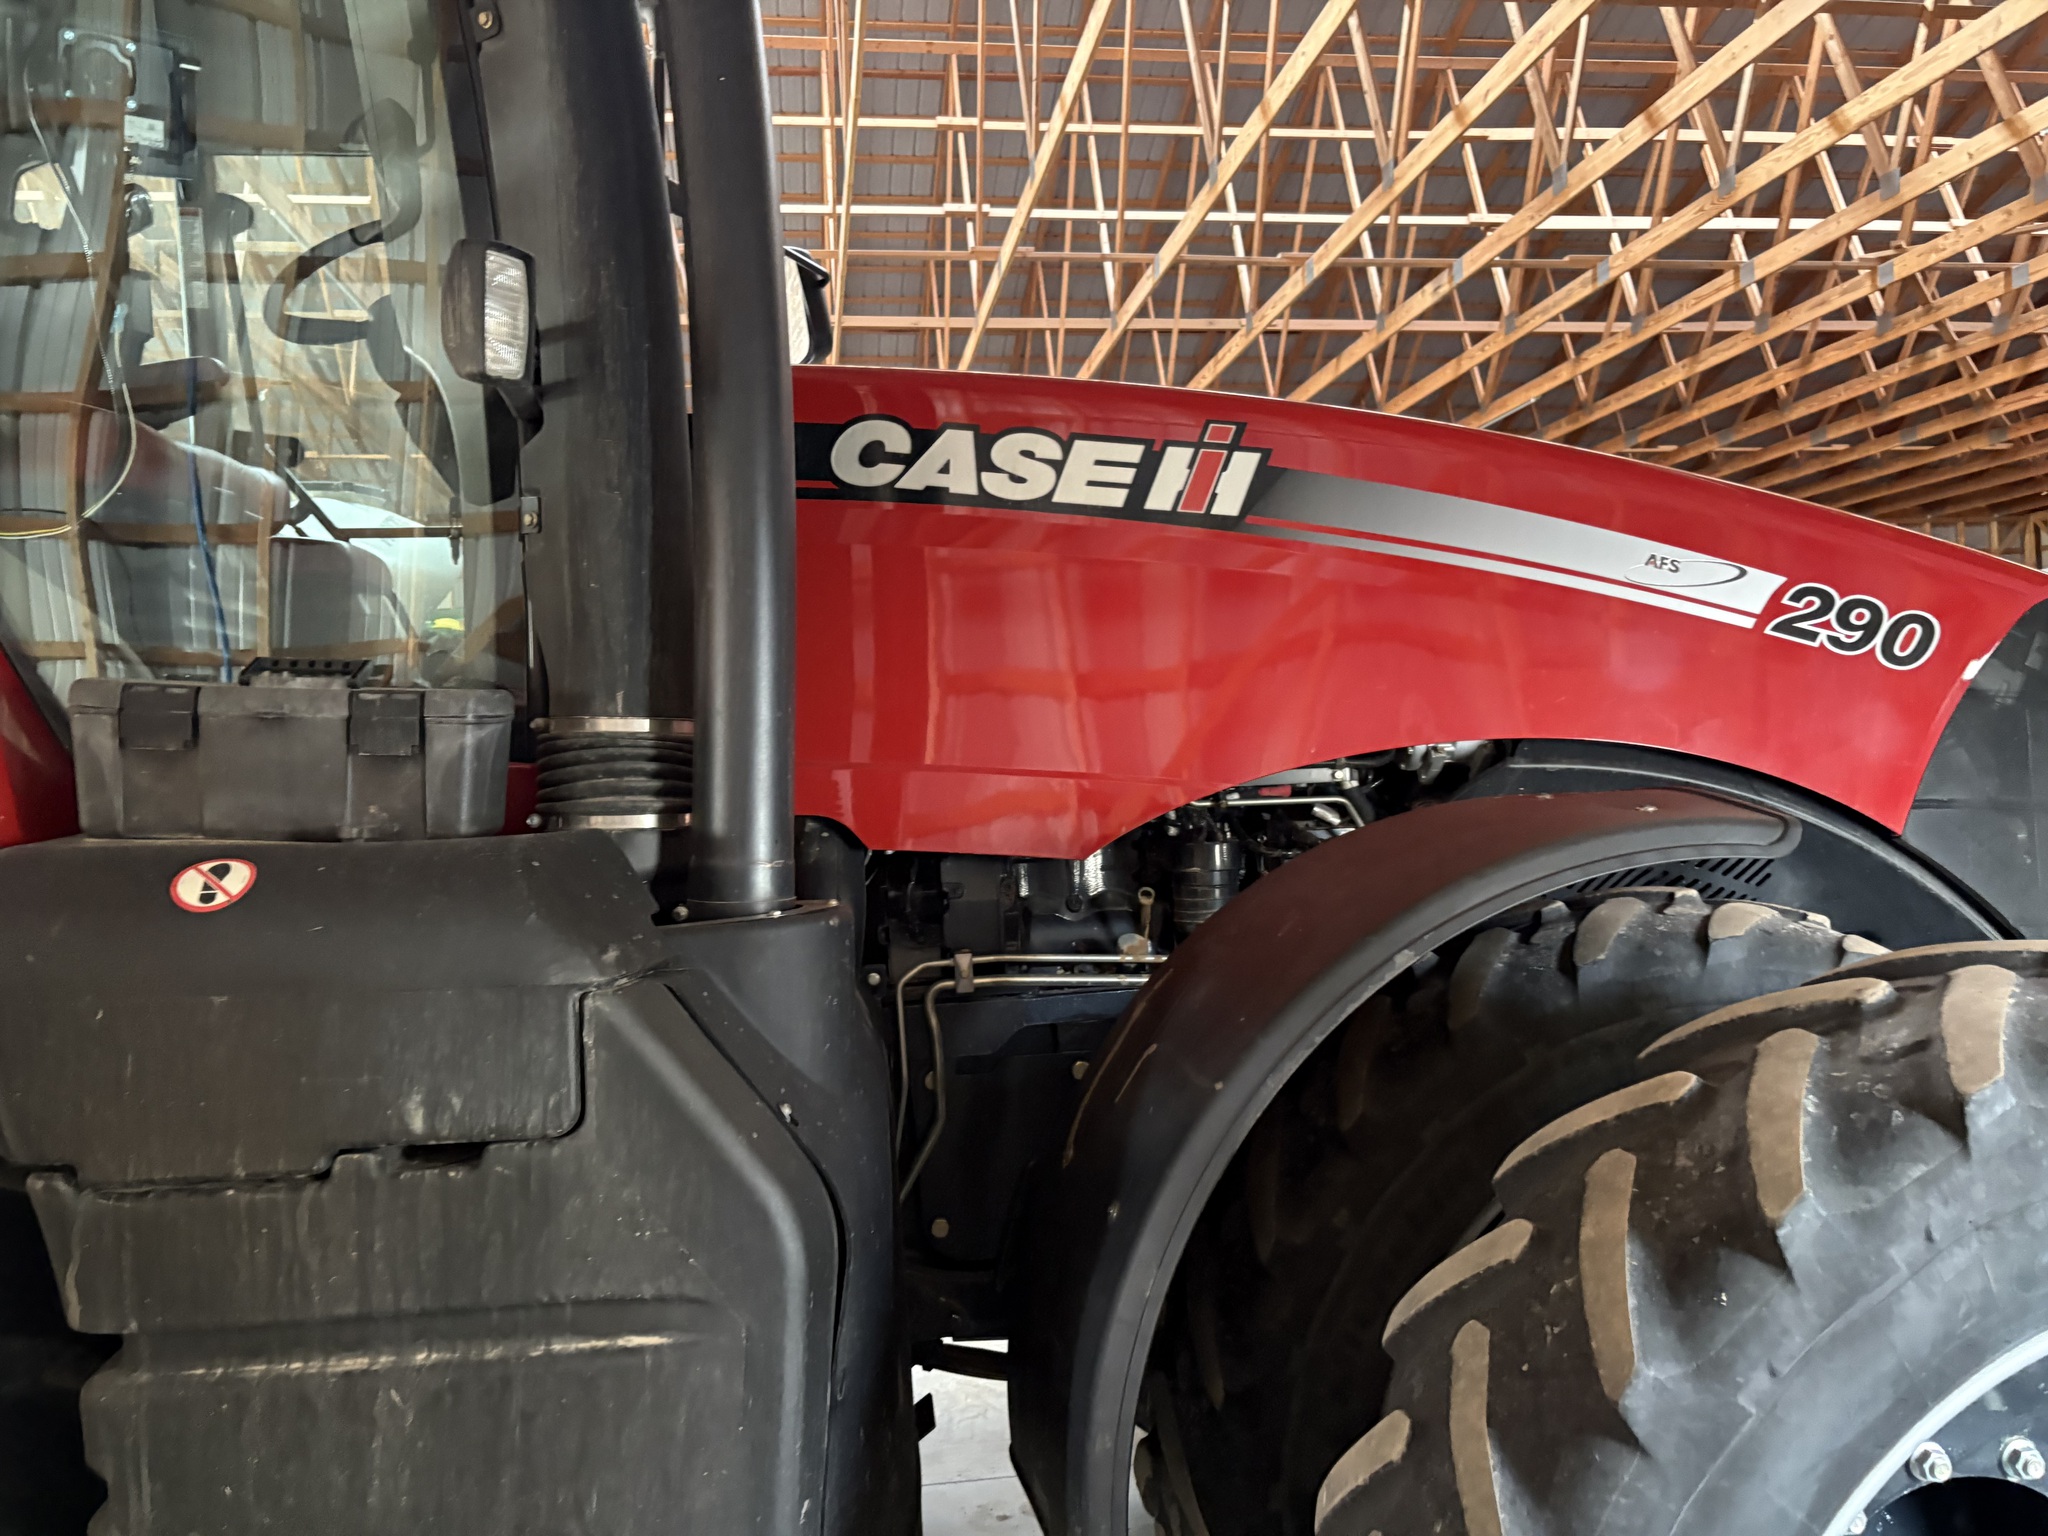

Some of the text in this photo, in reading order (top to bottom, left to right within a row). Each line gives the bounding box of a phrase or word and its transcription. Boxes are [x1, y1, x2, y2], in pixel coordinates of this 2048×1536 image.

[830, 419, 1146, 507] CASE
[1644, 553, 1681, 574] AFS
[1764, 582, 1942, 671] 290
